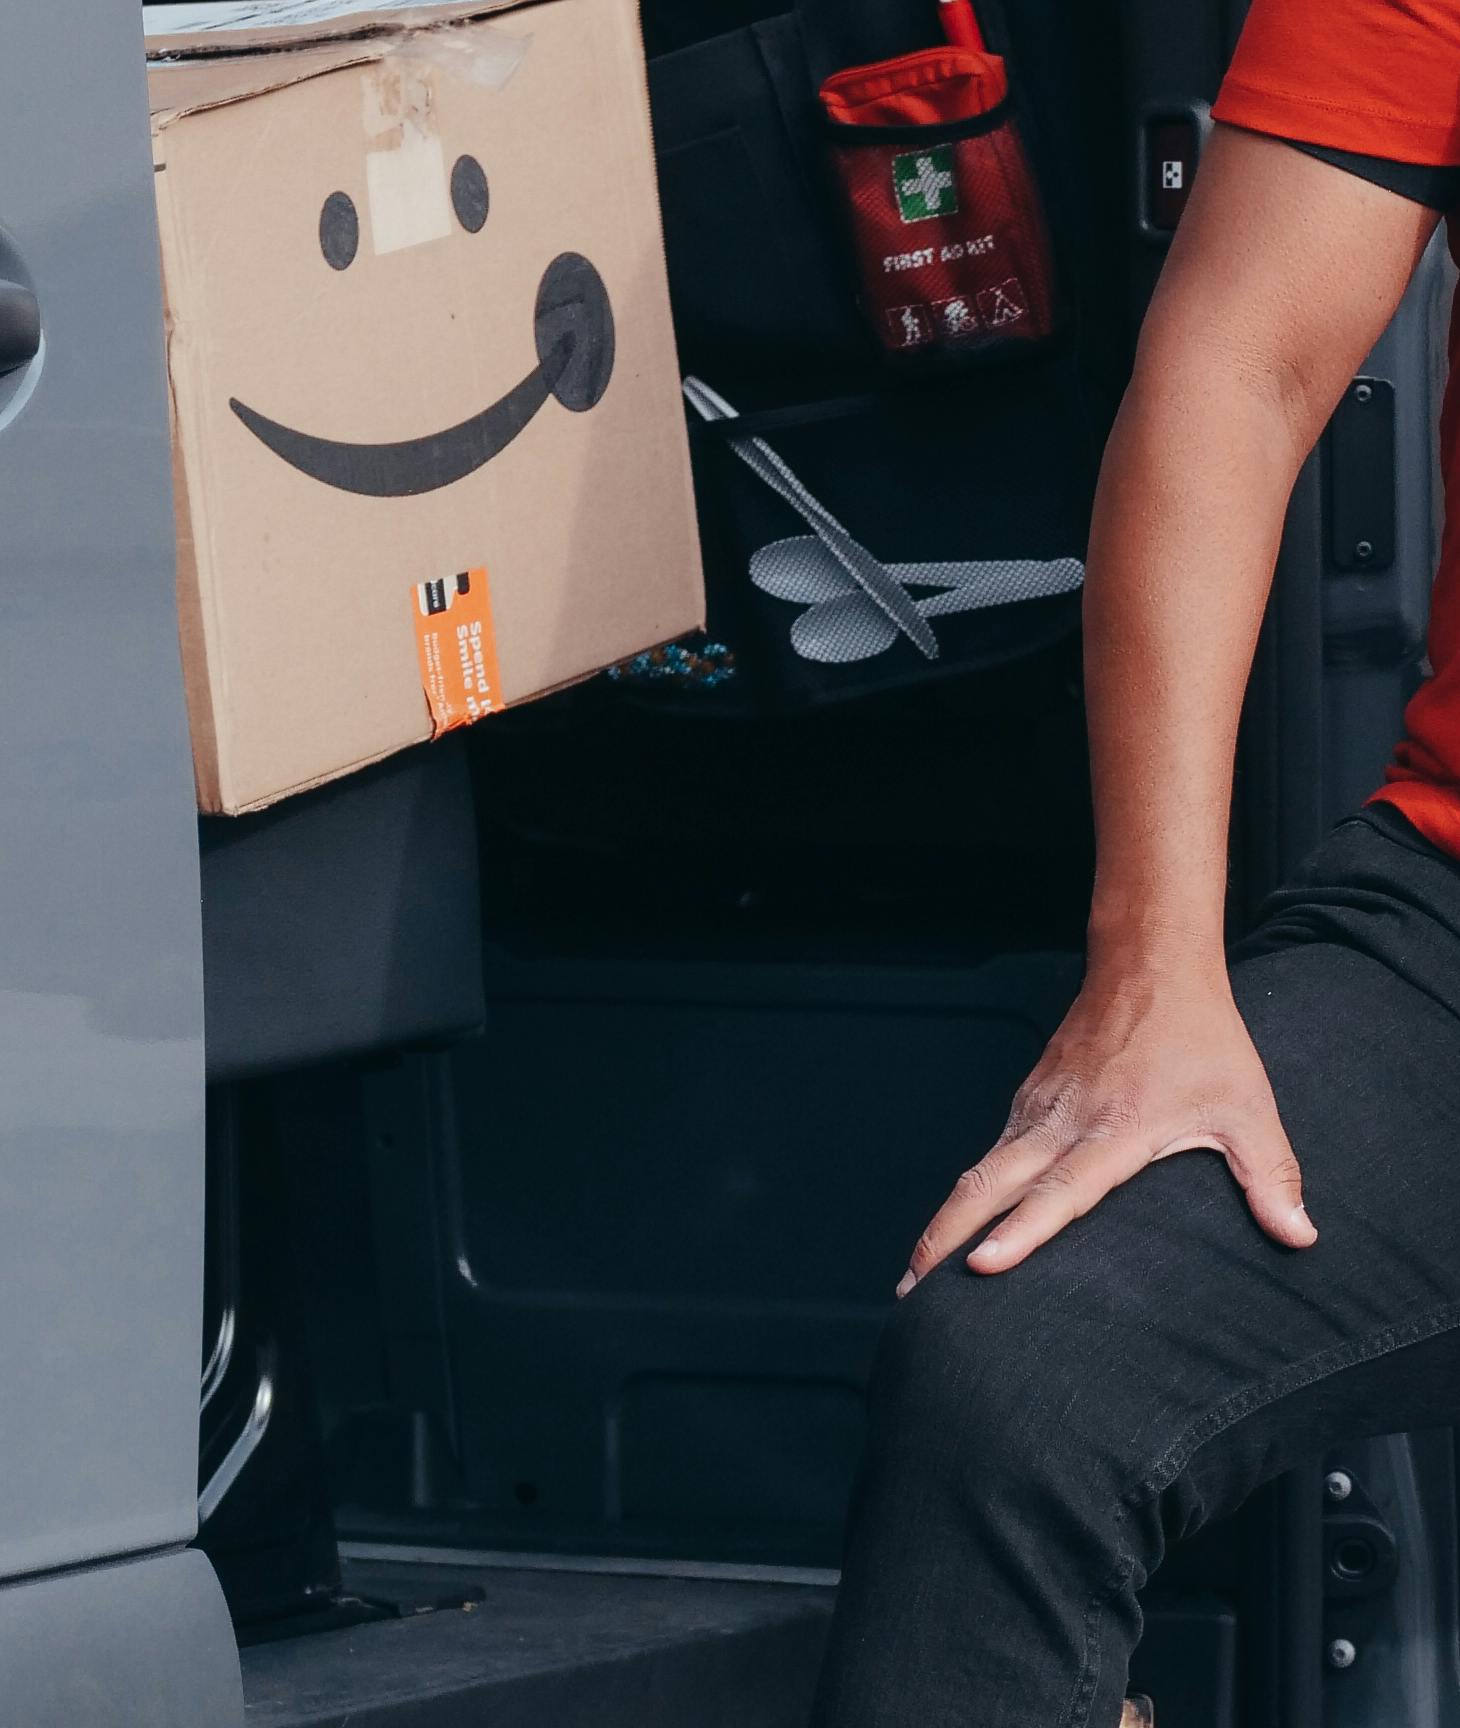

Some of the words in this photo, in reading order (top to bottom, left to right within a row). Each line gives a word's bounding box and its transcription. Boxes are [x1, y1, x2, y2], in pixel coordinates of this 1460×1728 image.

[883, 247, 934, 272] FIRST
[966, 234, 995, 256] KIT
[456, 624, 474, 690] Smile
[469, 621, 491, 693] Spend
